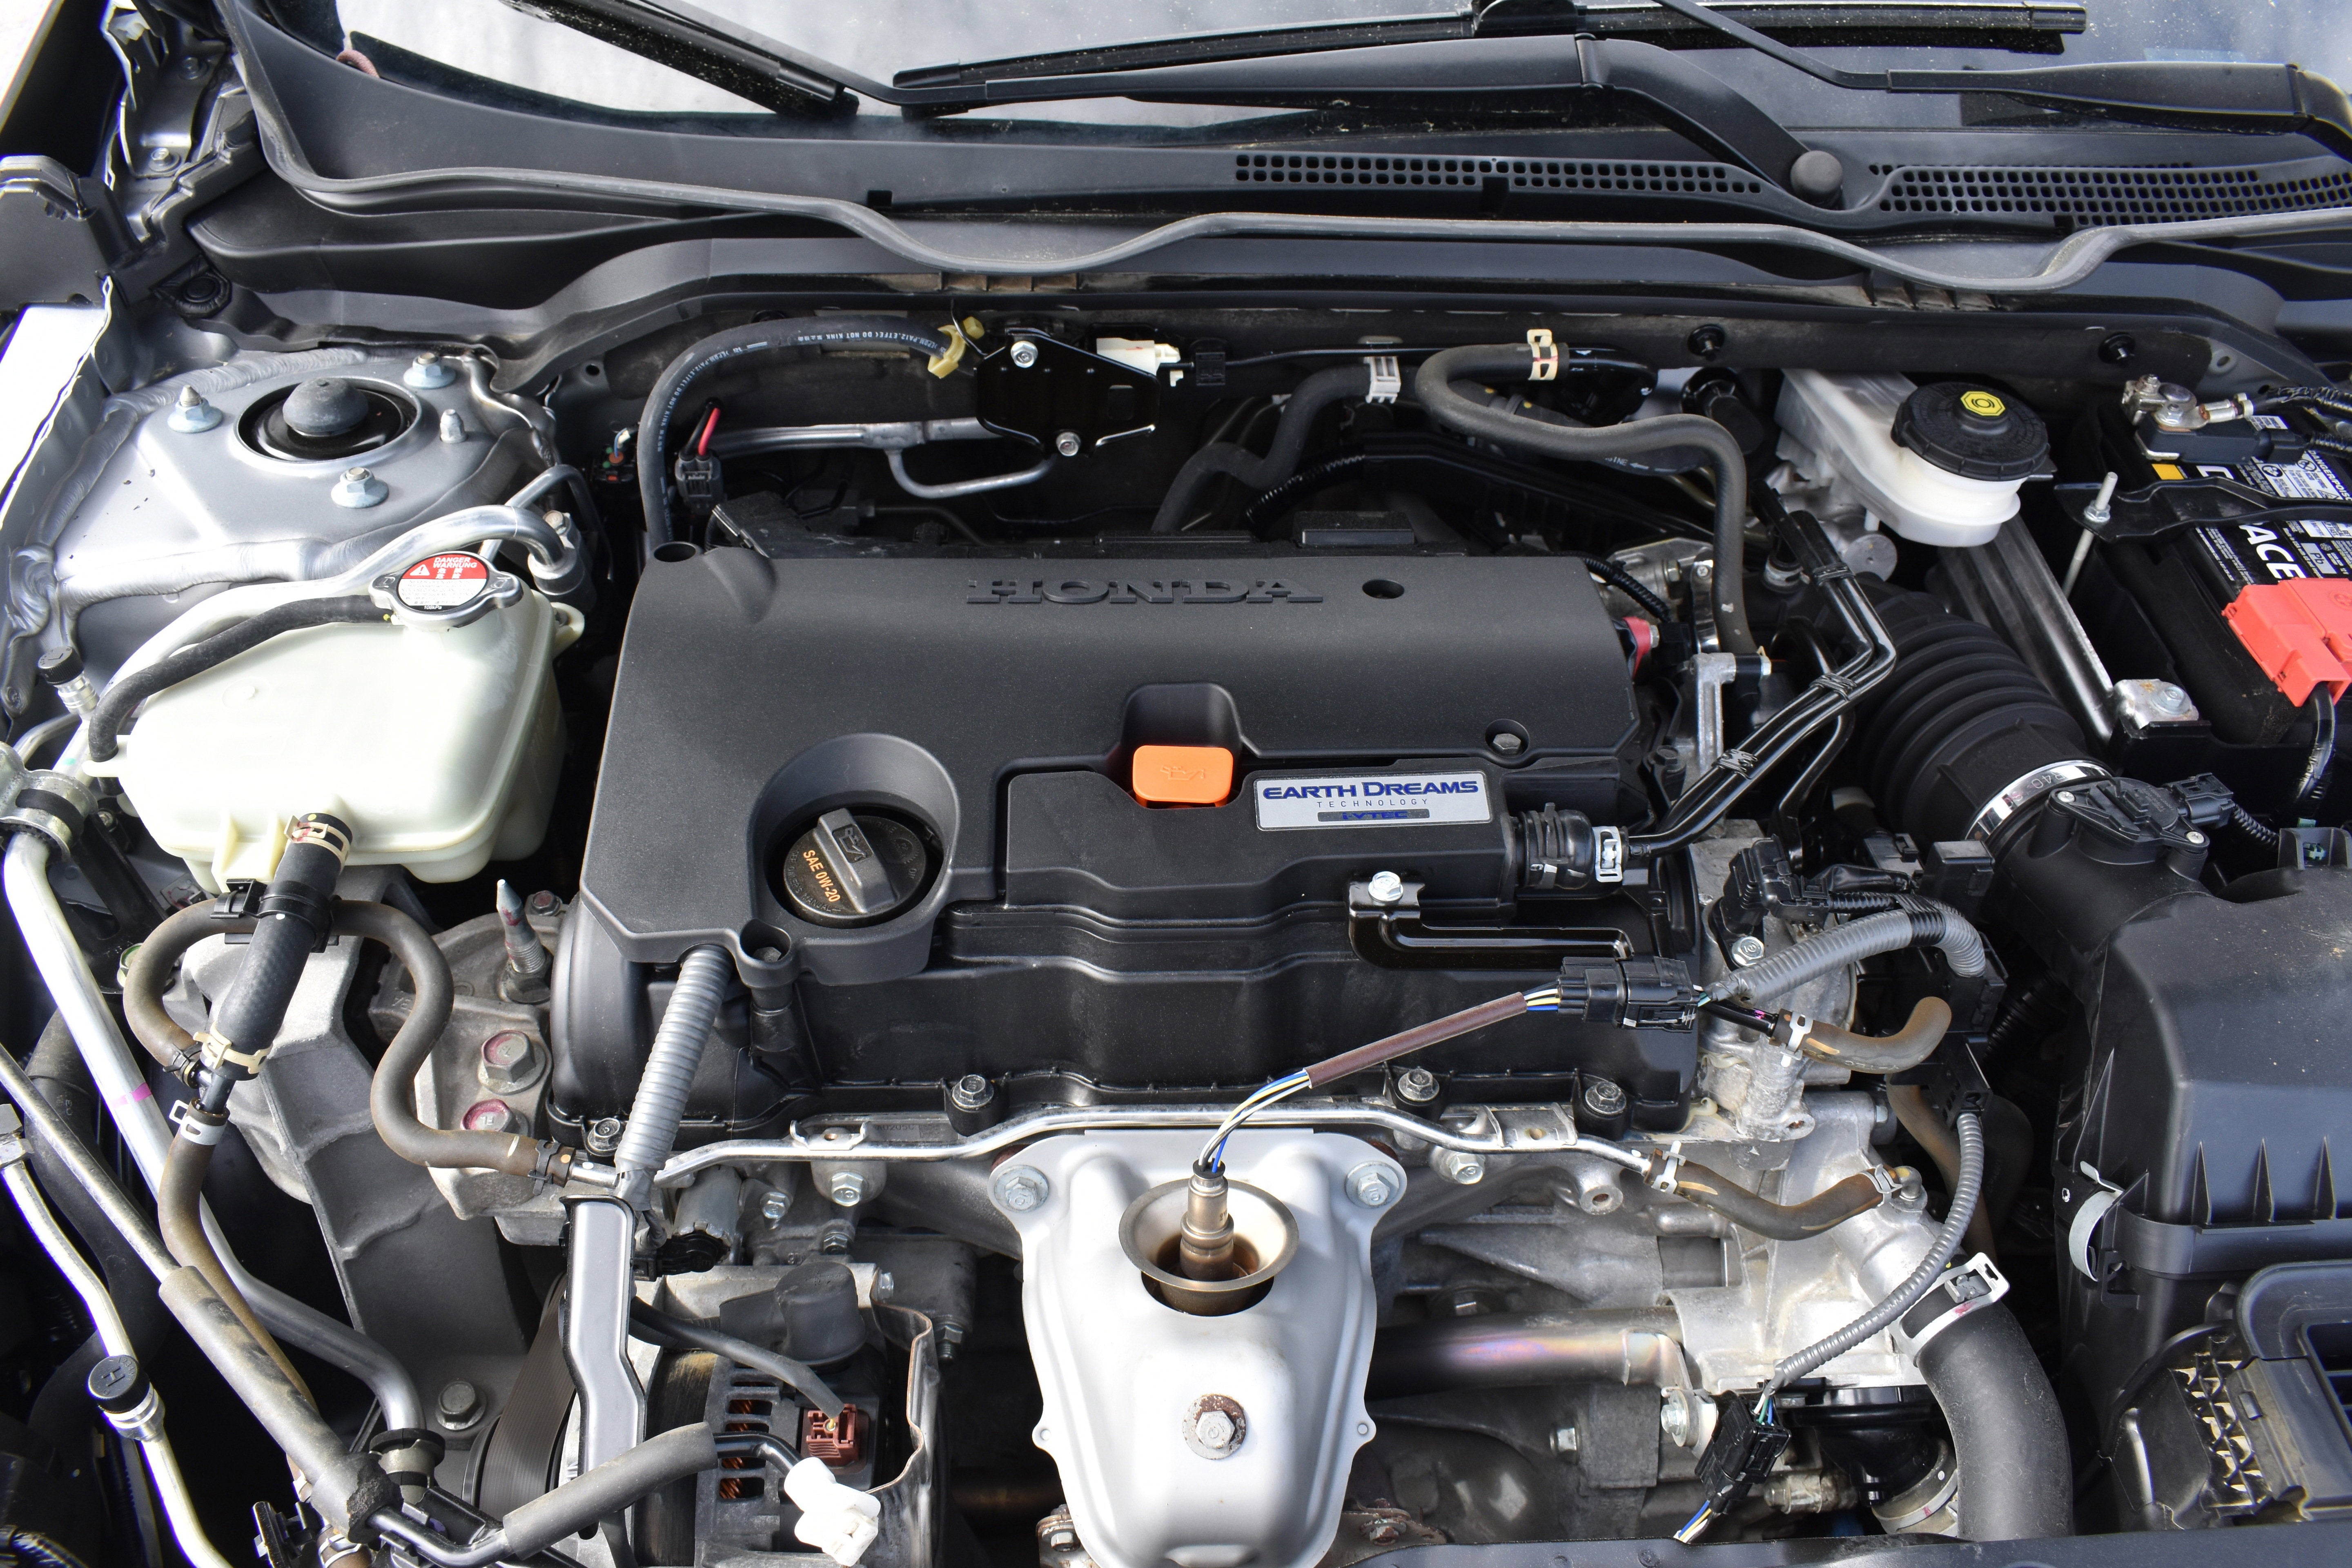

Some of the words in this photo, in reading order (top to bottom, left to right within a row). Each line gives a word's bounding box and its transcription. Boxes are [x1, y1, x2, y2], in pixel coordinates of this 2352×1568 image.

[2310, 552, 2324, 564] Pb
[966, 578, 1323, 604] HONDA
[1263, 786, 1357, 800] EARTH
[1361, 781, 1479, 796] DREAMS
[1317, 798, 1428, 808] TECHNOLOGY
[803, 850, 824, 872] SAE
[815, 871, 841, 902] 0W-20
